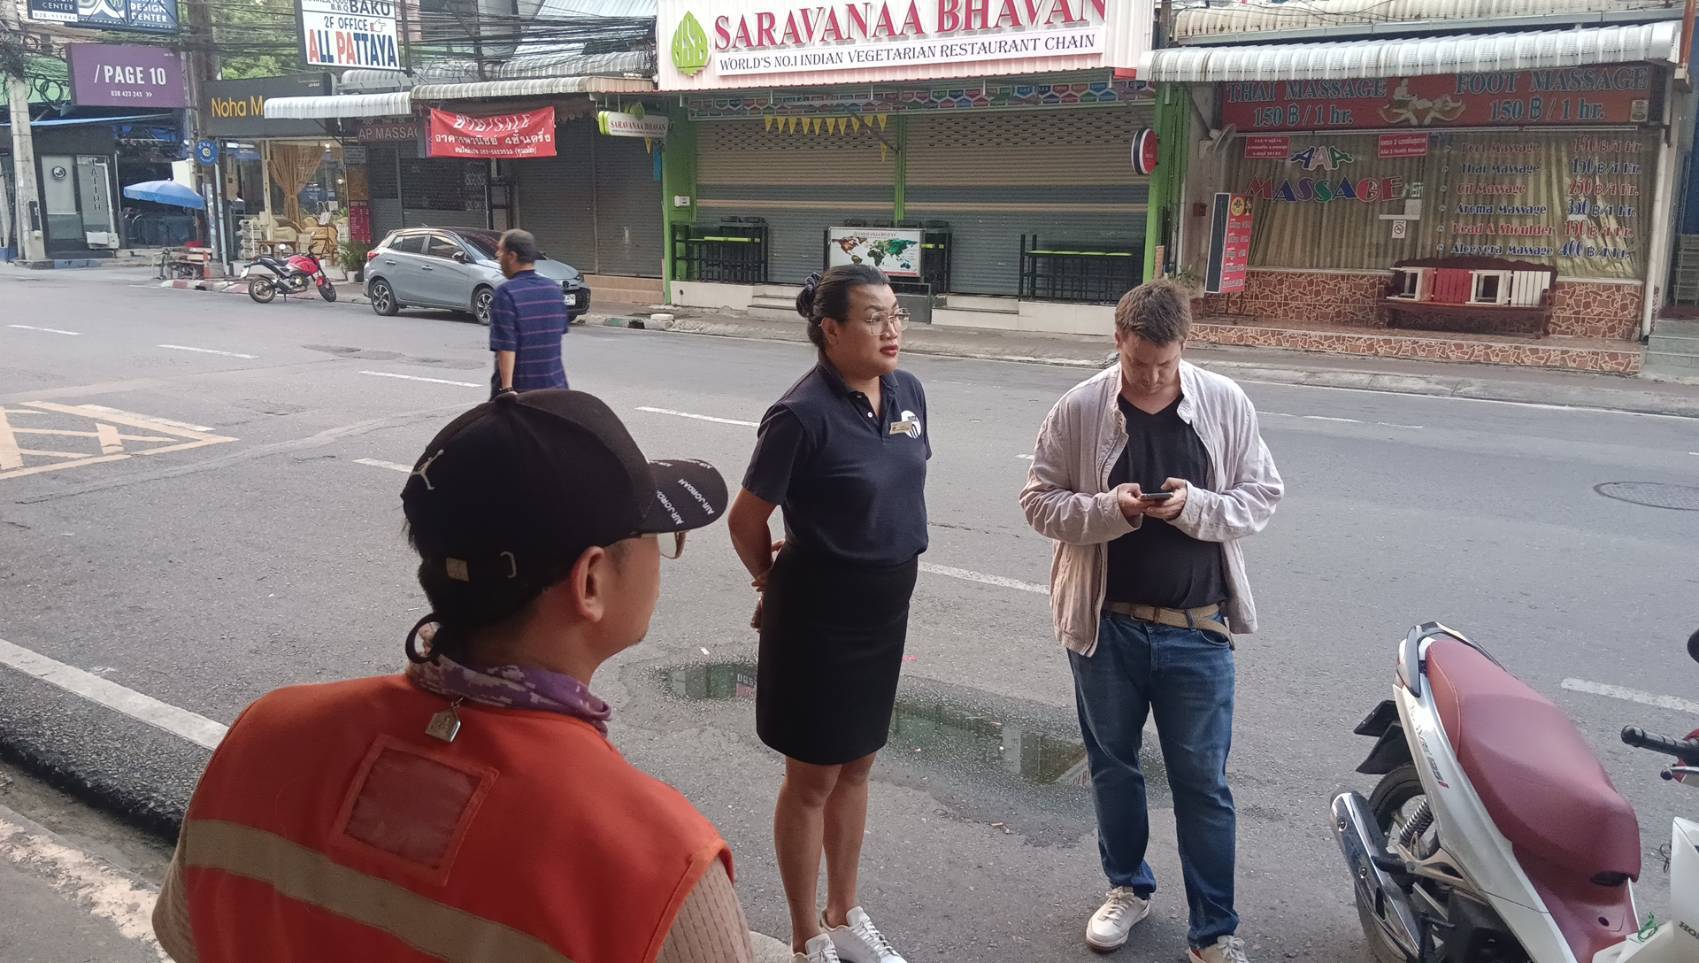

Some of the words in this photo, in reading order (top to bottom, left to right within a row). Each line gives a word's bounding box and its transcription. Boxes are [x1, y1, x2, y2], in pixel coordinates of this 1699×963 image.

[42, 3, 74, 11] CENTER
[130, 3, 167, 14] DESIGN
[350, 0, 391, 16] BAKU
[324, 16, 335, 28] 2F
[338, 18, 369, 31] OFFICE
[714, 0, 925, 50] SARAVANAA
[936, 0, 1106, 33] BHAVAN
[309, 29, 334, 63] ALL
[336, 31, 398, 67] PATTAYA
[719, 55, 772, 71] WORLD'S
[800, 52, 844, 66] INDIAN
[847, 45, 938, 64] VEGETARIAN
[940, 38, 1041, 58] RESTAURANT
[1044, 34, 1096, 50] CHAIN
[103, 65, 146, 84] PAGE
[149, 67, 167, 85] 10
[1455, 71, 1521, 96] FOOT
[1529, 65, 1650, 92] MASSAGE
[1227, 80, 1278, 103] THAI
[1285, 78, 1388, 100] MASSAGE
[211, 97, 247, 118] Noha
[1253, 106, 1284, 127] 150
[1490, 99, 1525, 122] 150
[1288, 145, 1354, 171] AAA
[1246, 176, 1404, 203] MASSAGE
[678, 478, 706, 503] JORDAN
[671, 511, 684, 525] AIR
[702, 502, 715, 515] AIR
